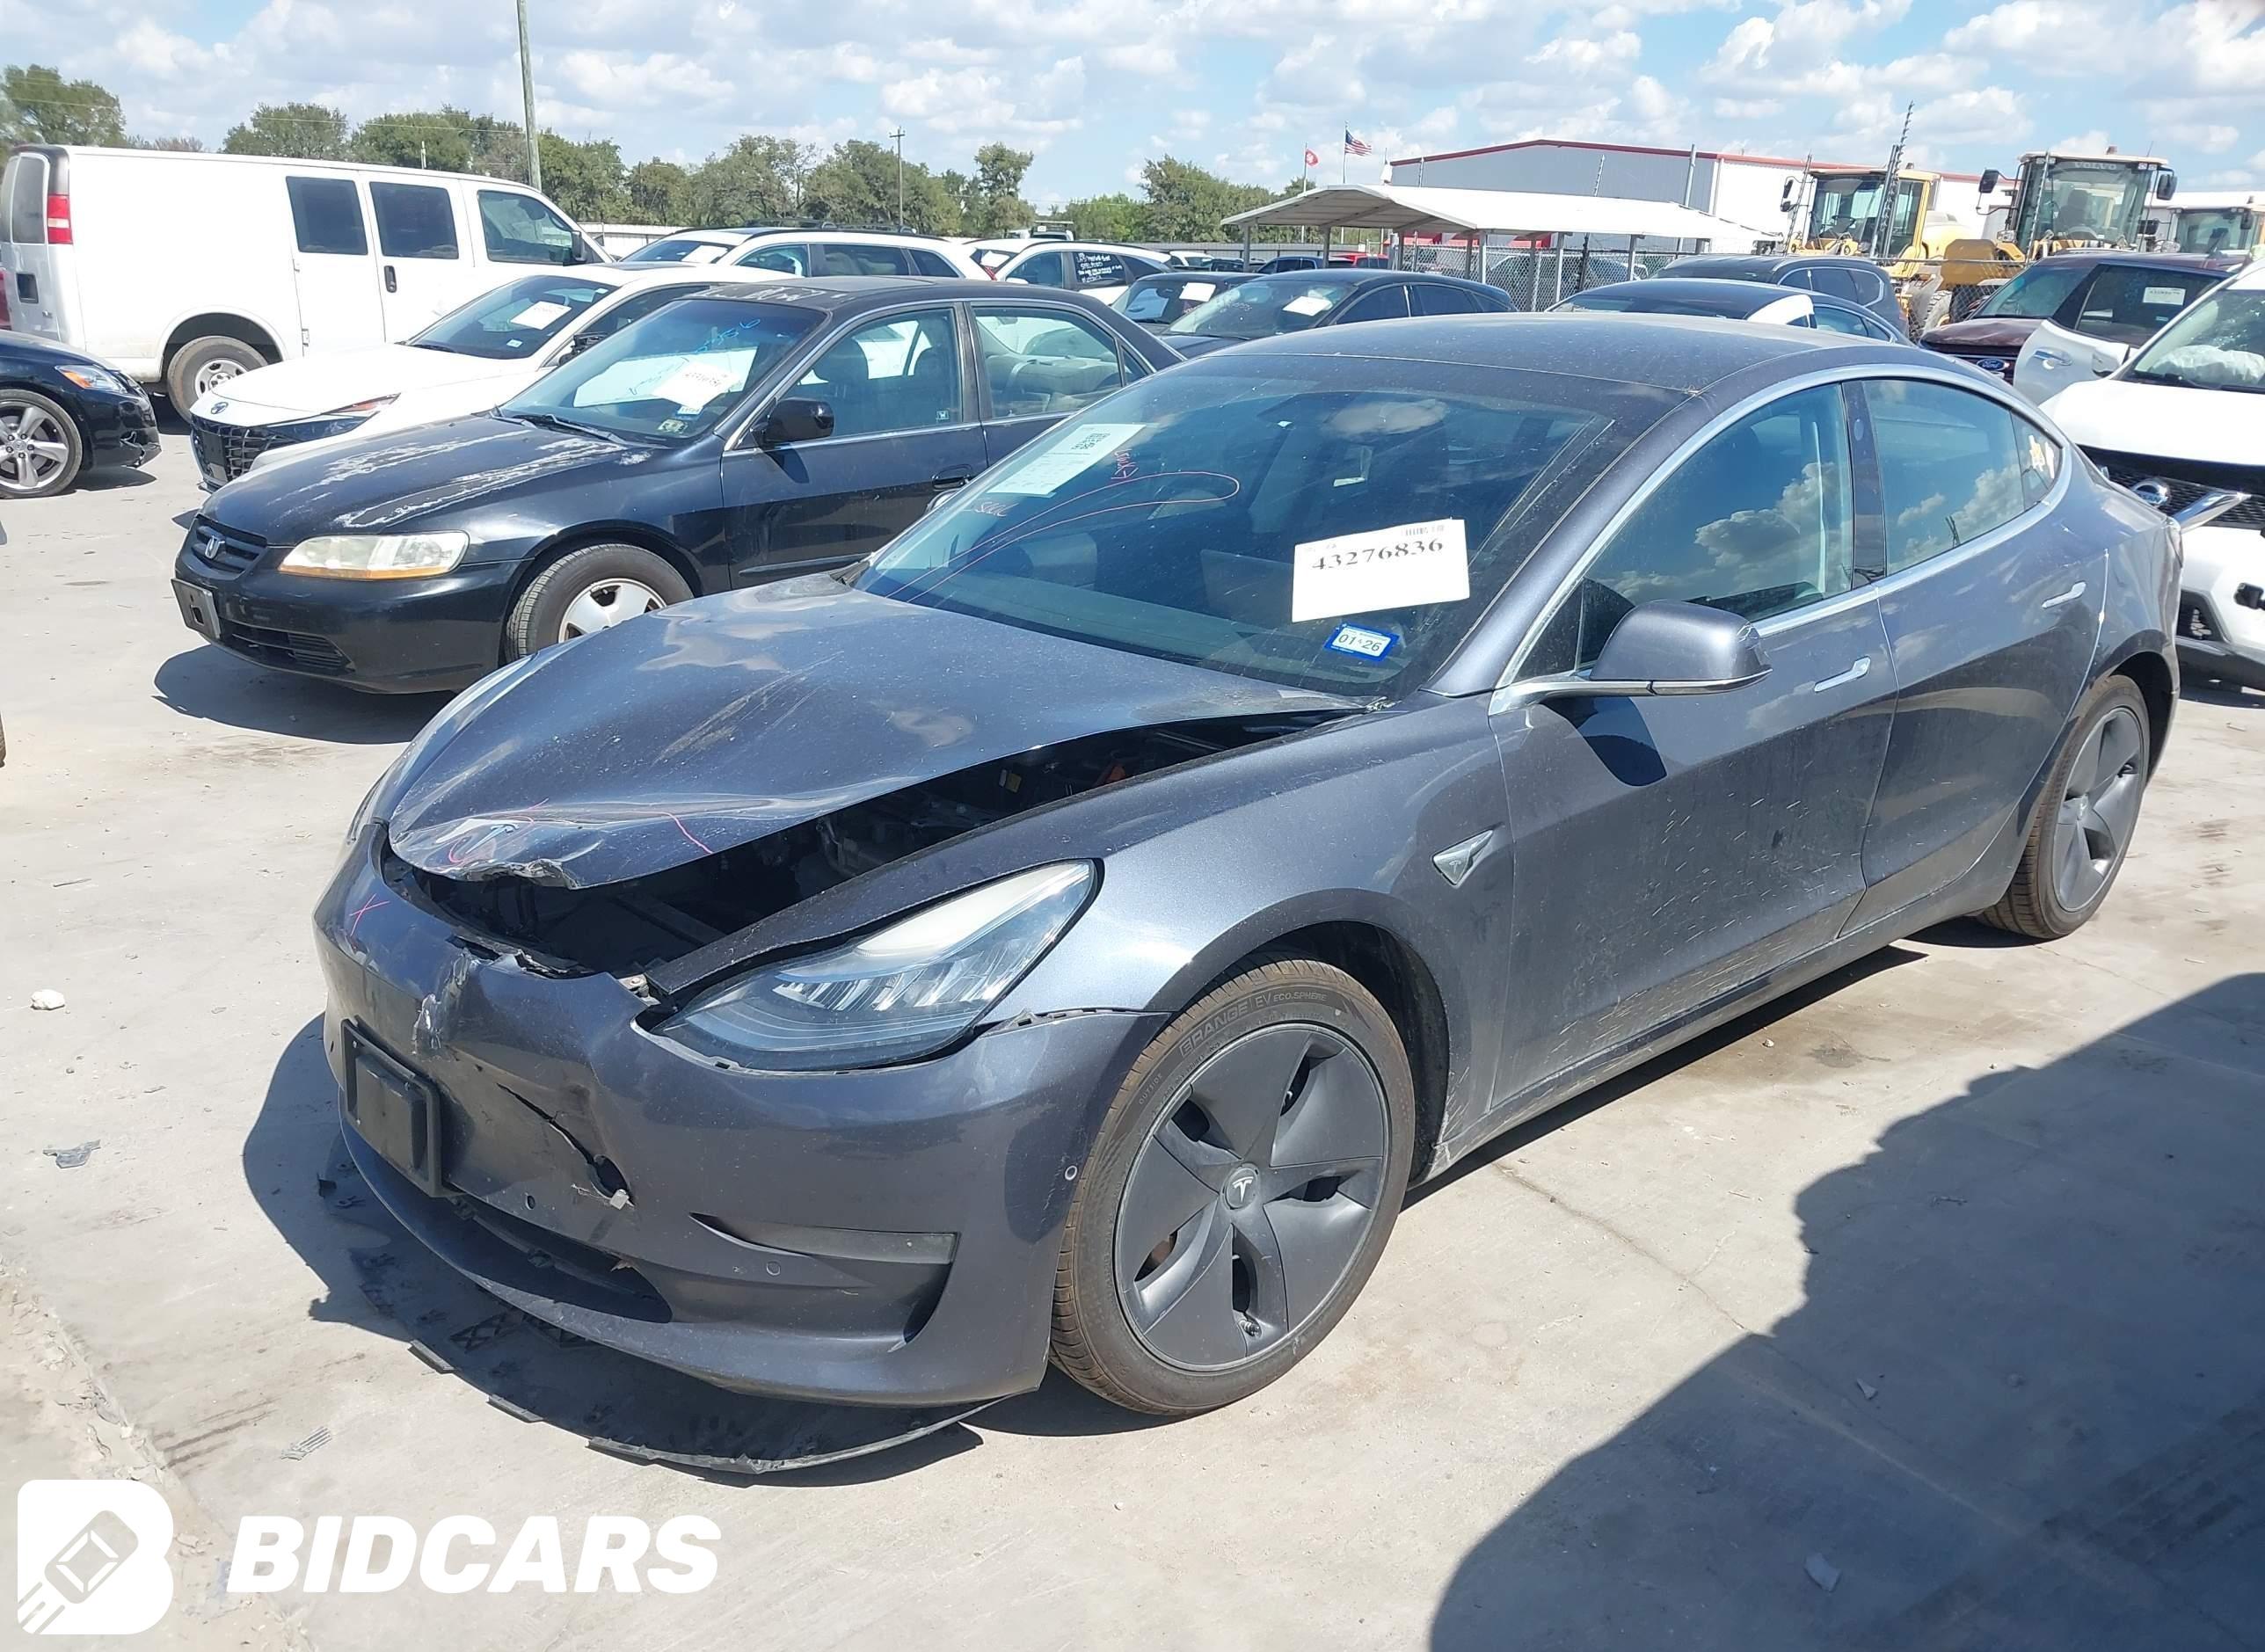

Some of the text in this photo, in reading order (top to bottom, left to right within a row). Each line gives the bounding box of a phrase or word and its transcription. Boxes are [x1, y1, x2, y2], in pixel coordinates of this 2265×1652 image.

[2075, 162, 2117, 171] VOLVO
[1312, 537, 1444, 570] 43276836
[1338, 634, 1357, 645] 01
[1361, 639, 1382, 651] 26
[1255, 993, 1273, 1008] EV
